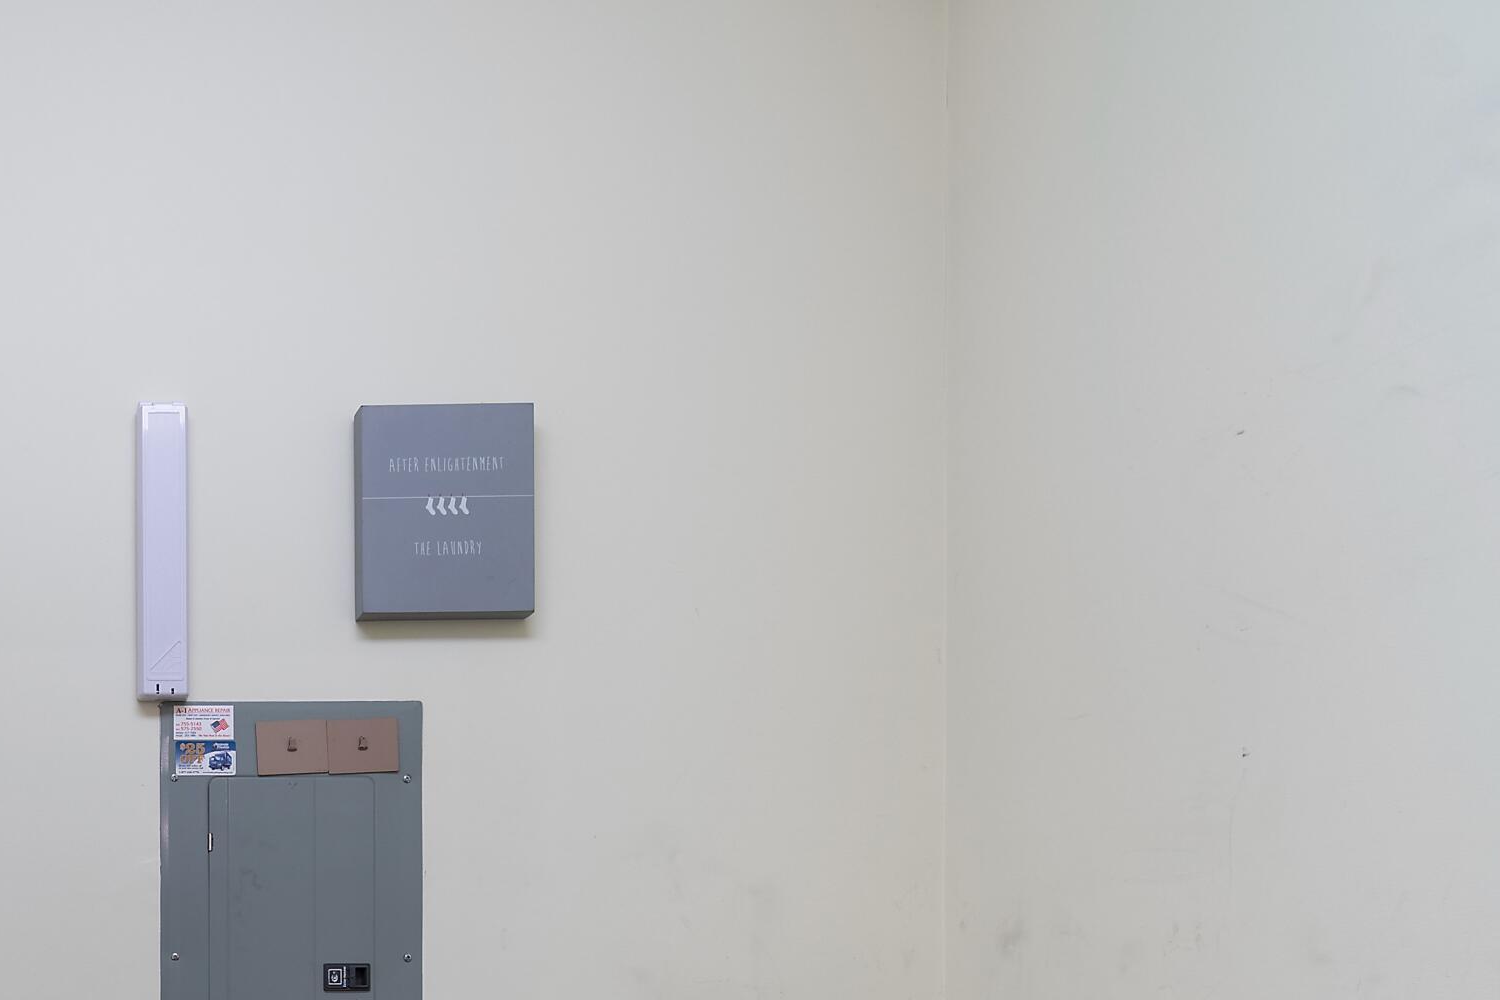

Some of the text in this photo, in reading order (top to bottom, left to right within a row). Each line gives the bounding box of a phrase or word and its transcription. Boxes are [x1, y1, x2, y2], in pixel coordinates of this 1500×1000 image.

[389, 455, 506, 473] AFTER ENLIGHTENMENT
[414, 539, 484, 556] THE LAUNDRY
